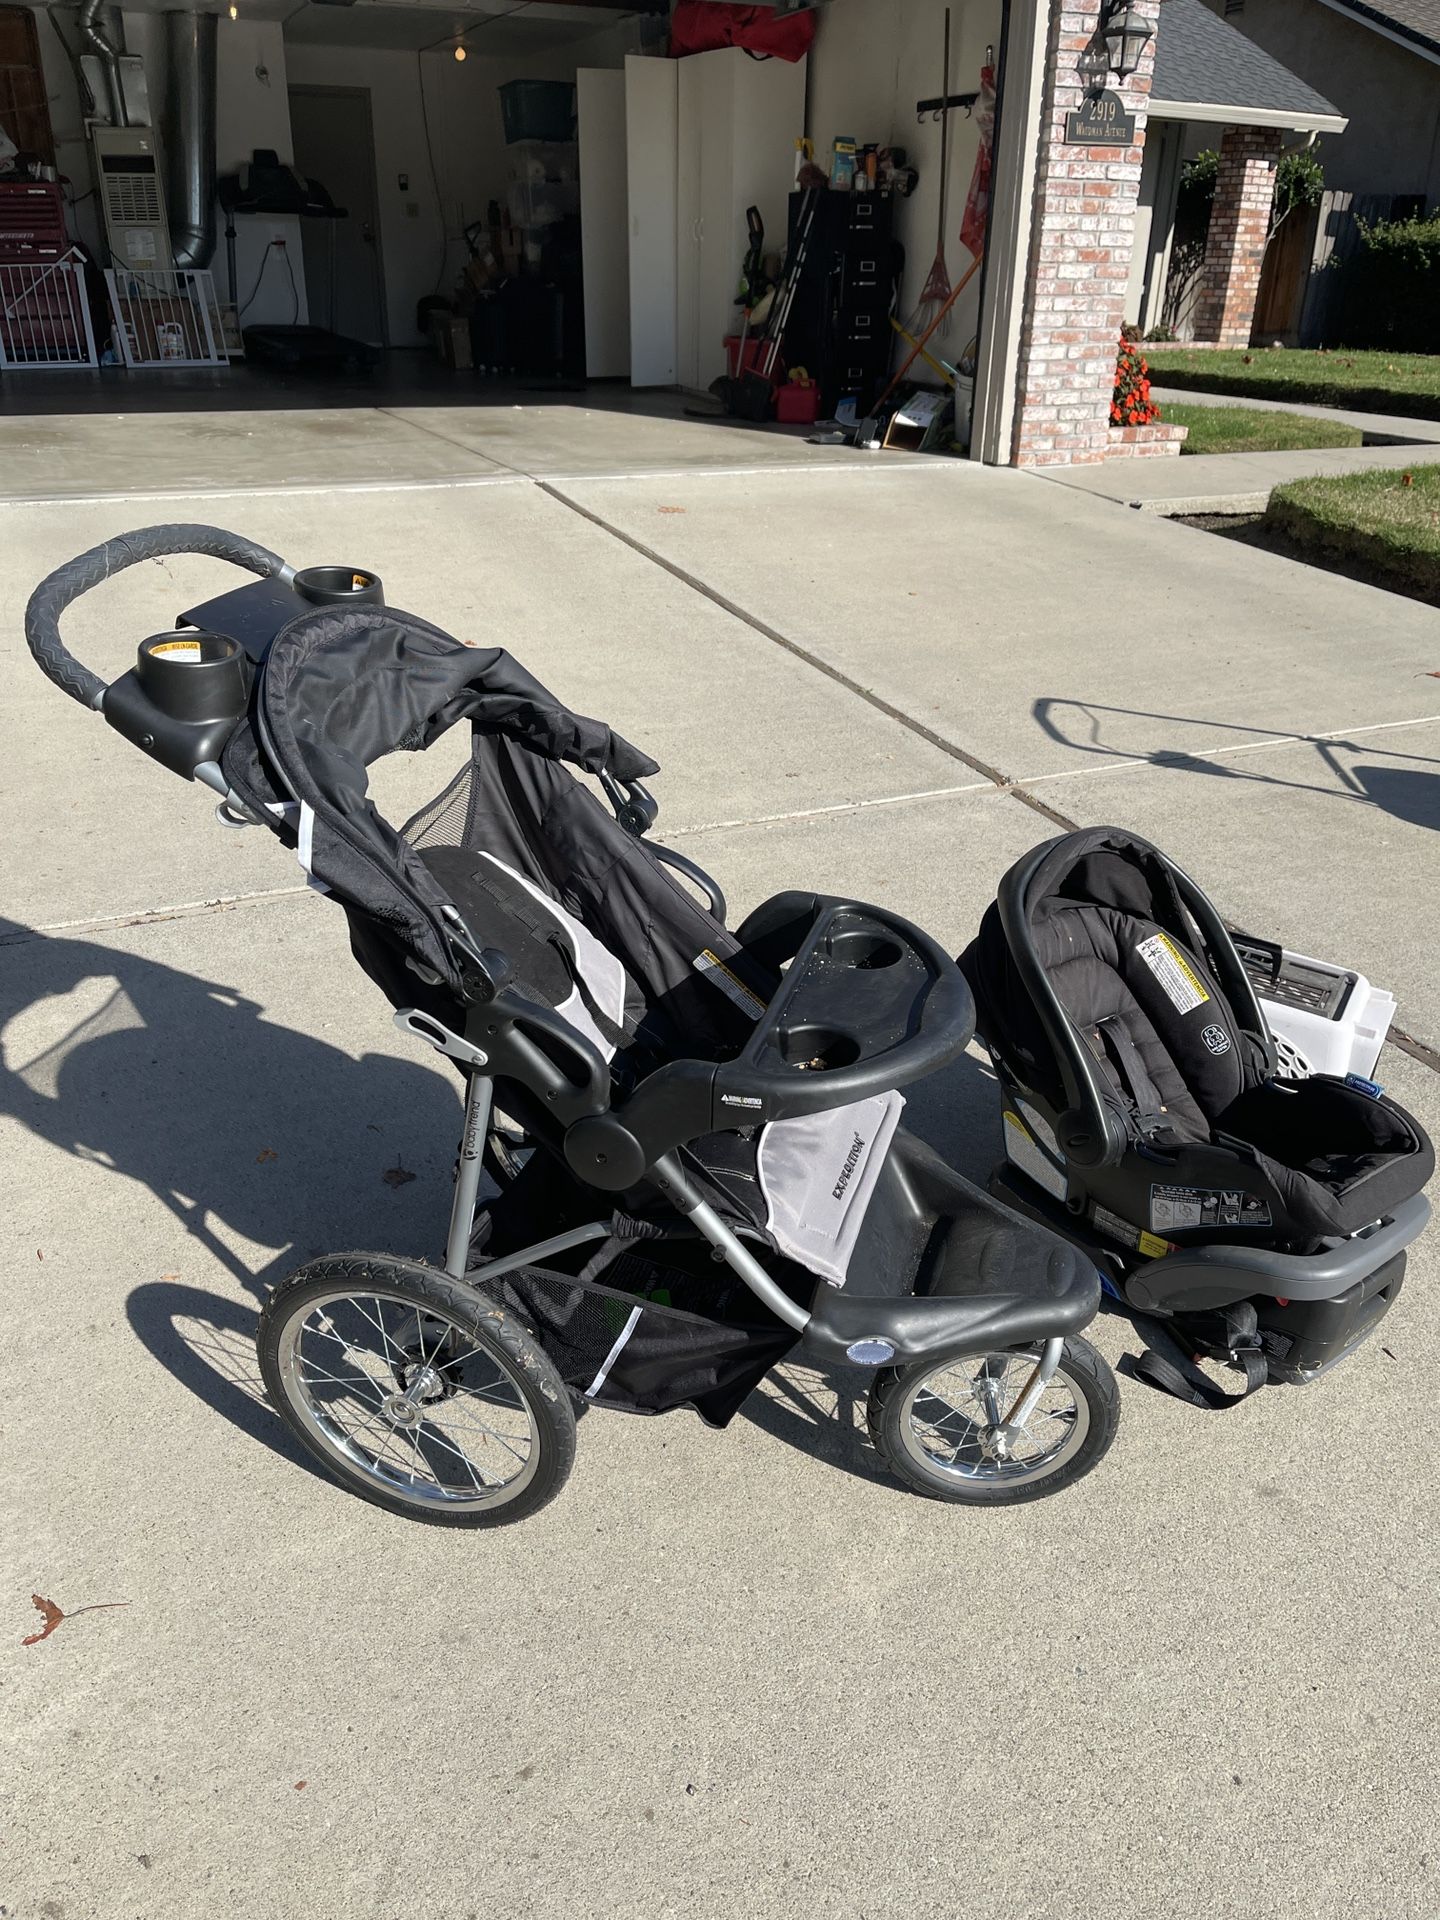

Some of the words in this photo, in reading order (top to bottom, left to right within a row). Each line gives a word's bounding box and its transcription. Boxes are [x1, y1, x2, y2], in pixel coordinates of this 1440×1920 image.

[1089, 101, 1116, 121] 2919
[1104, 122, 1126, 137] AVENUE
[1182, 963, 1206, 998] ADVERTENCIA
